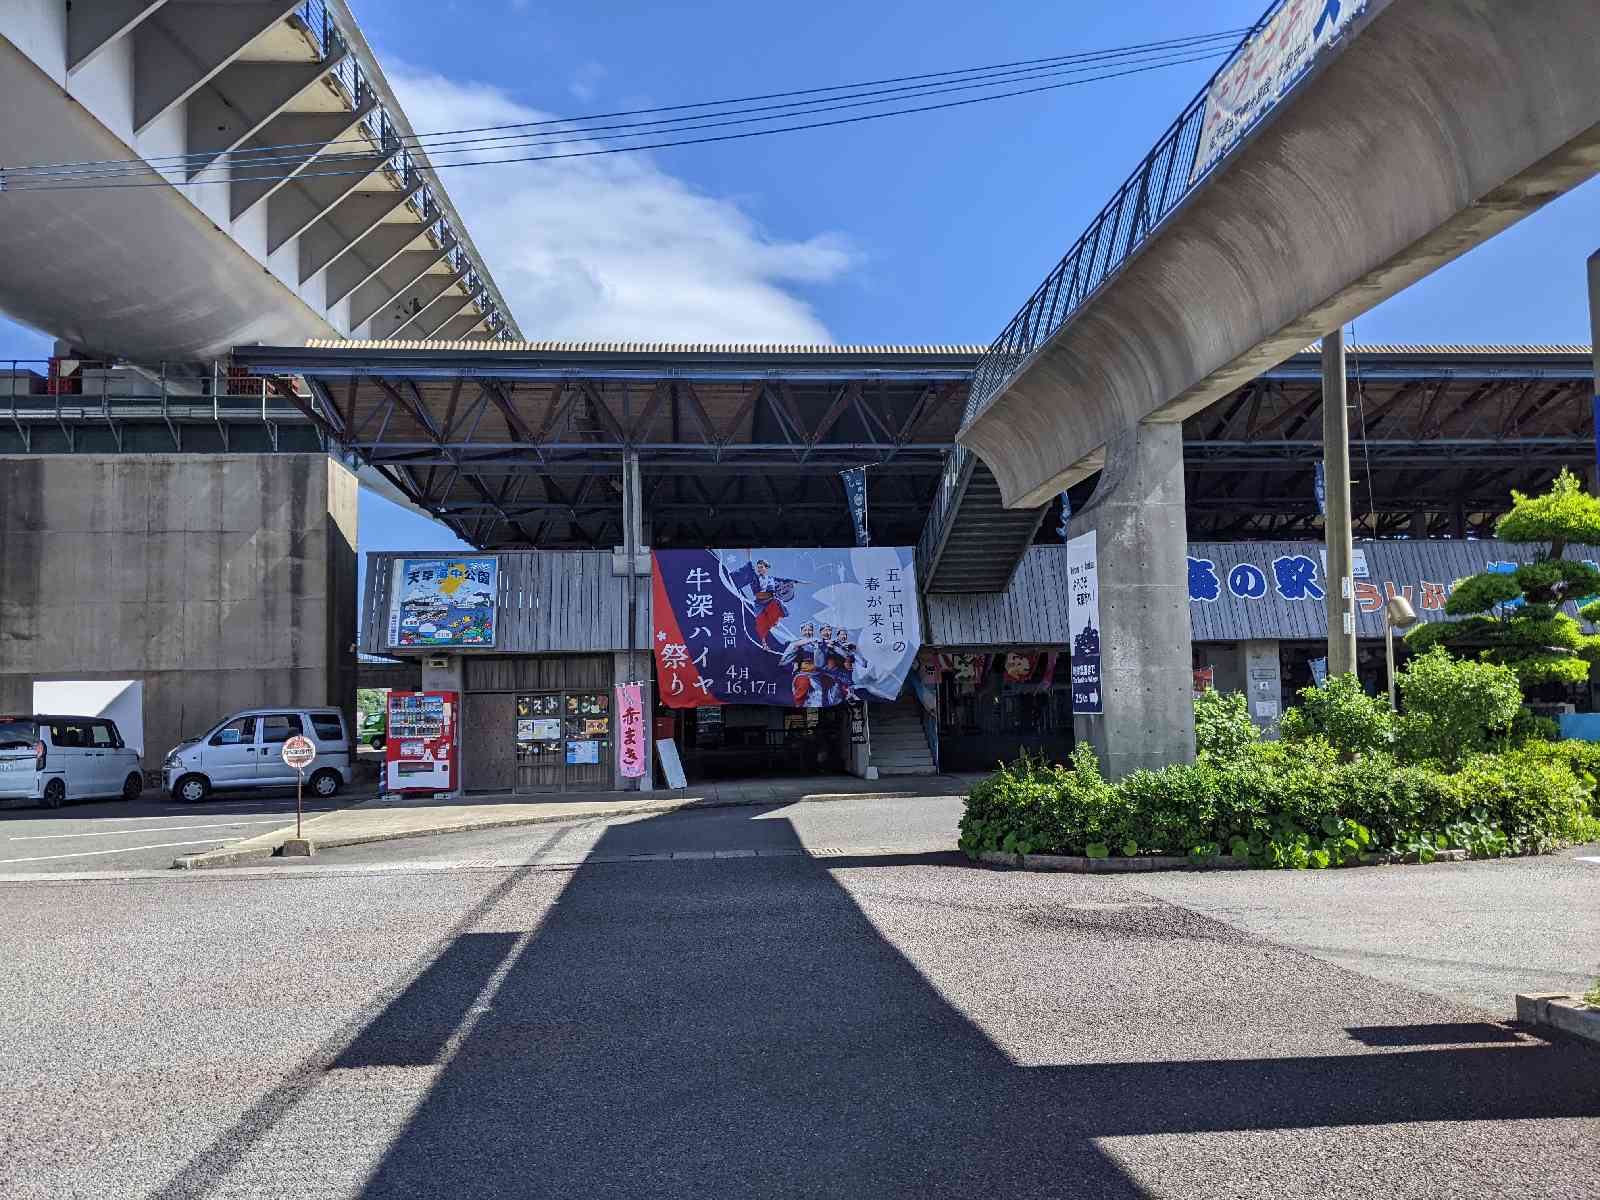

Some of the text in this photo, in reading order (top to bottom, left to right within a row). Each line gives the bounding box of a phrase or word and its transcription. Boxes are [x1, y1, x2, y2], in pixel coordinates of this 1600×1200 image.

[685, 567, 714, 695] 牛深ハイヤ
[722, 611, 737, 648] 第50回
[865, 577, 884, 644] 春が来る
[661, 643, 689, 696] 祭り
[726, 664, 750, 680] 4月
[622, 706, 641, 765] 赤まき
